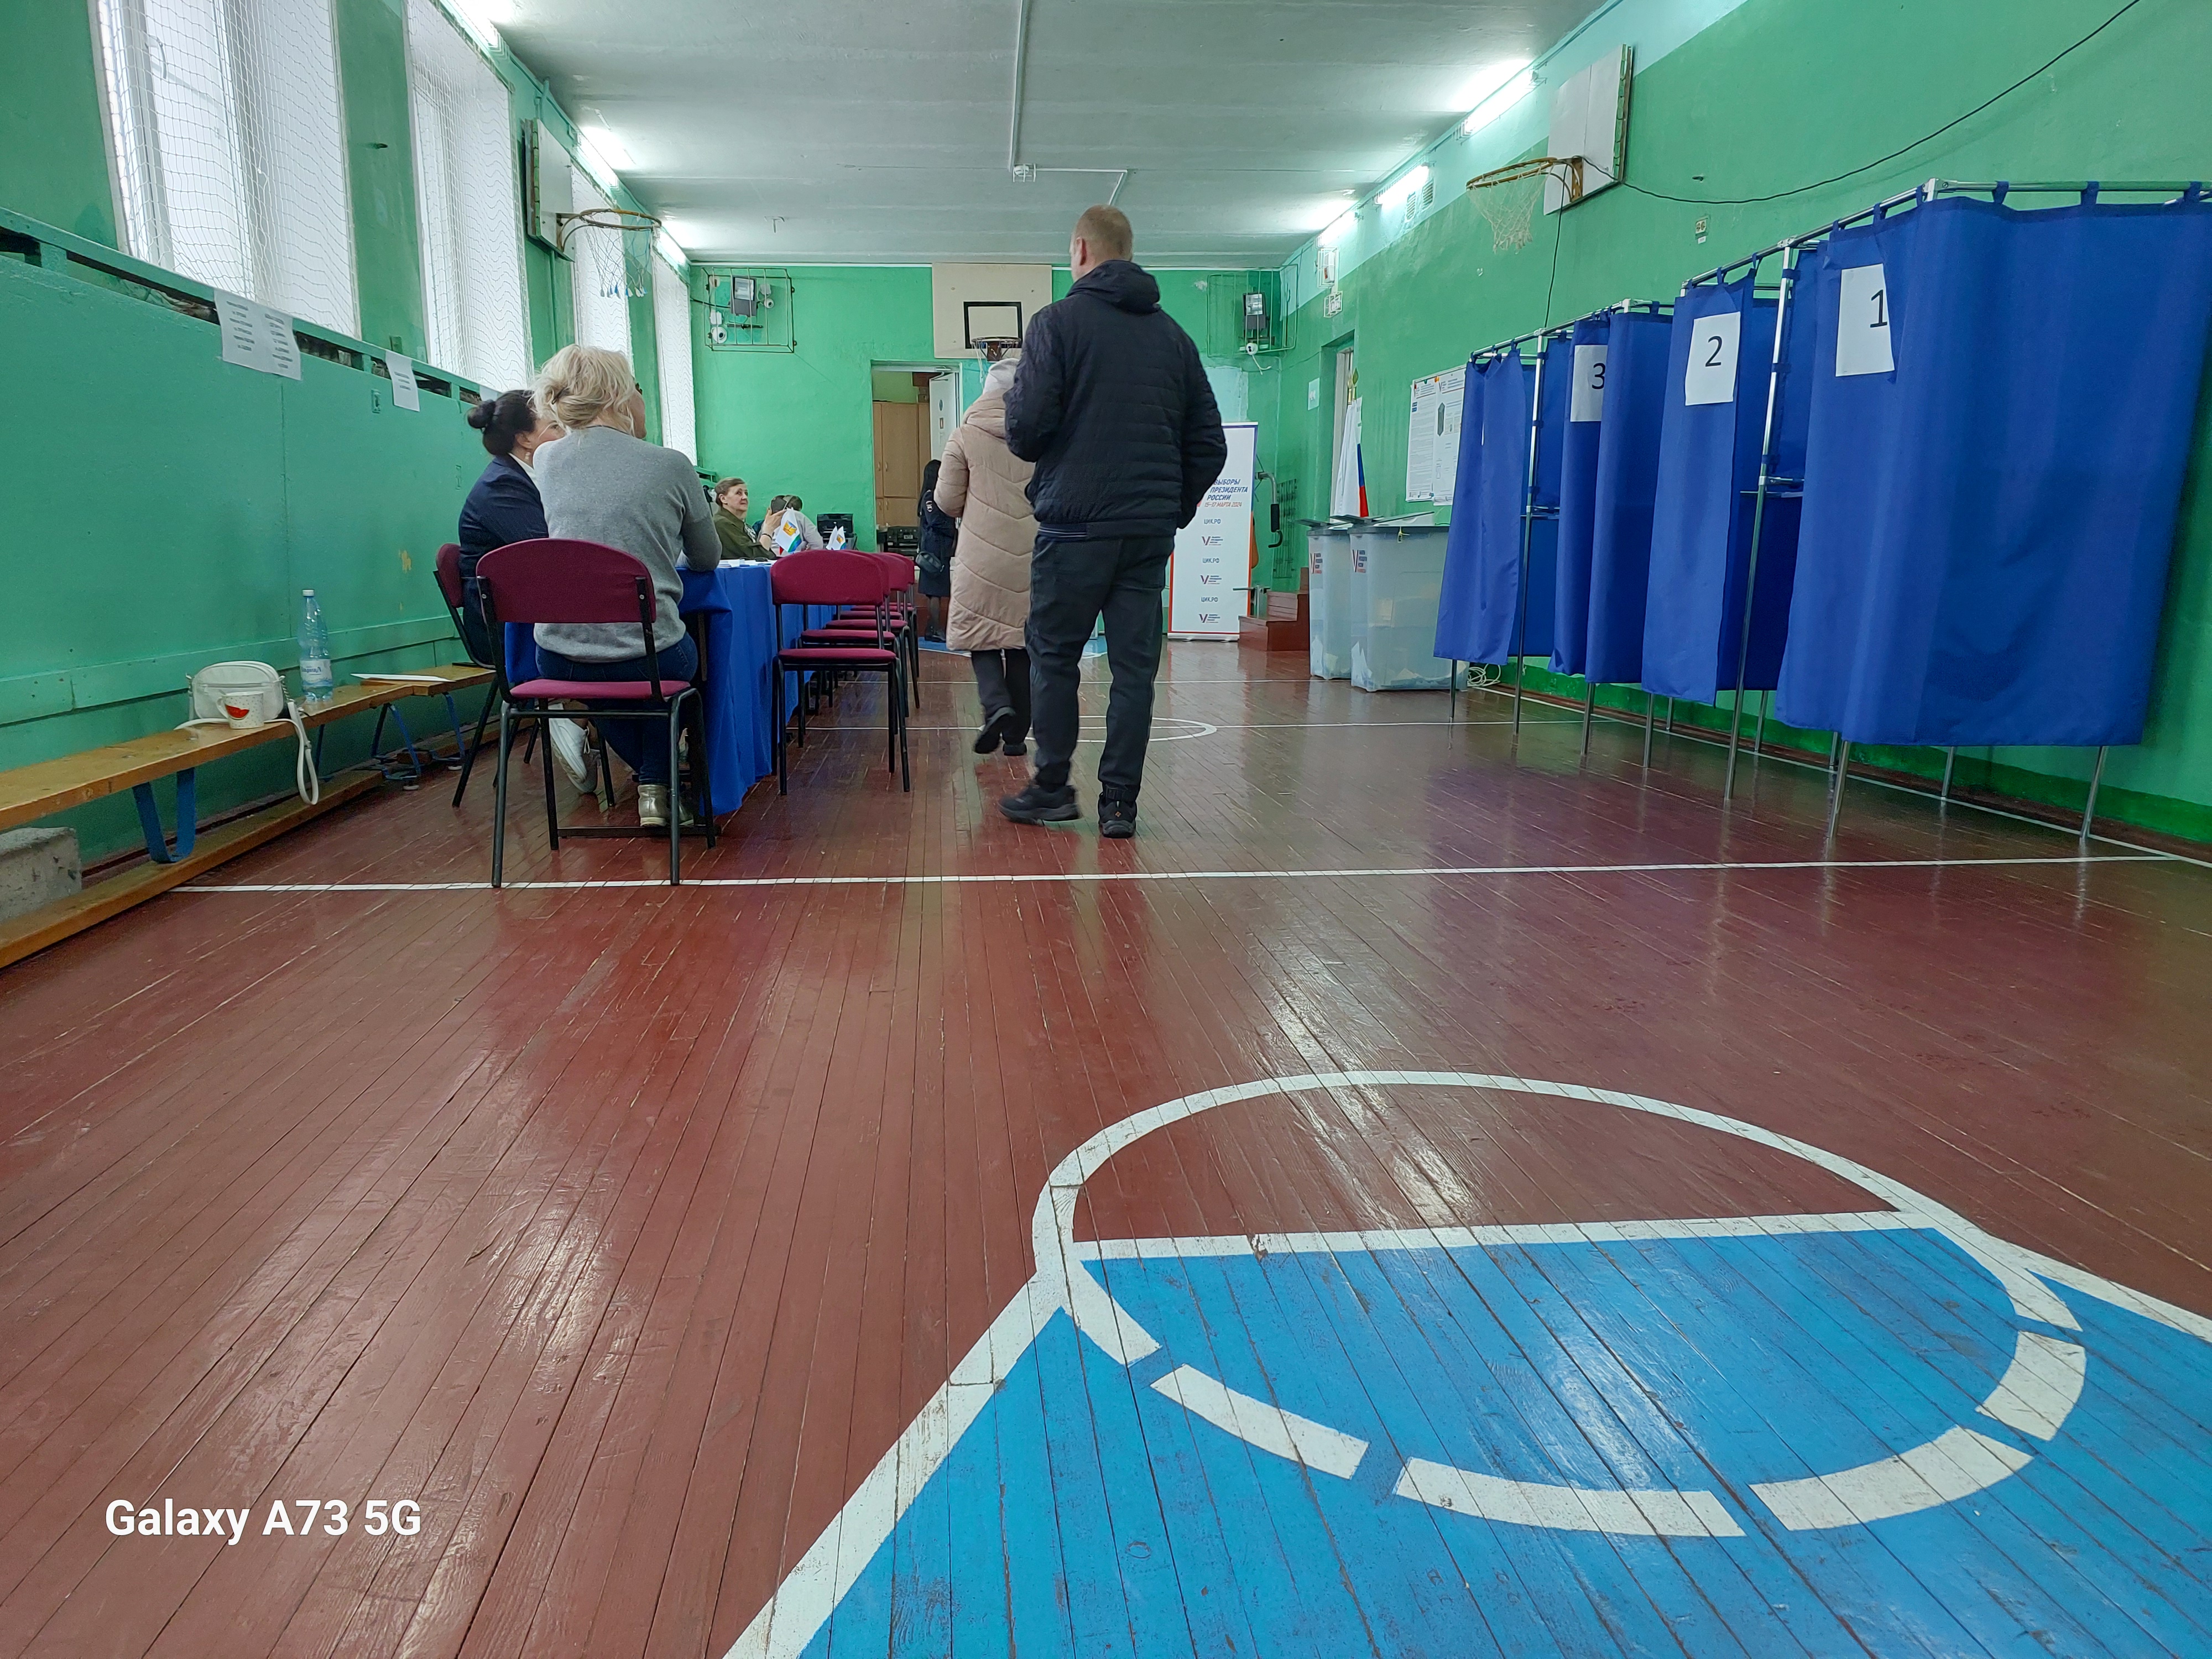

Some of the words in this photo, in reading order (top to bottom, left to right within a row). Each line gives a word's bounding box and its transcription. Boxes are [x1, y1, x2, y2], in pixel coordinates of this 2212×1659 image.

[1870, 289, 1888, 328] 1
[1705, 335, 1723, 367] 2
[1592, 362, 1606, 390] 3
